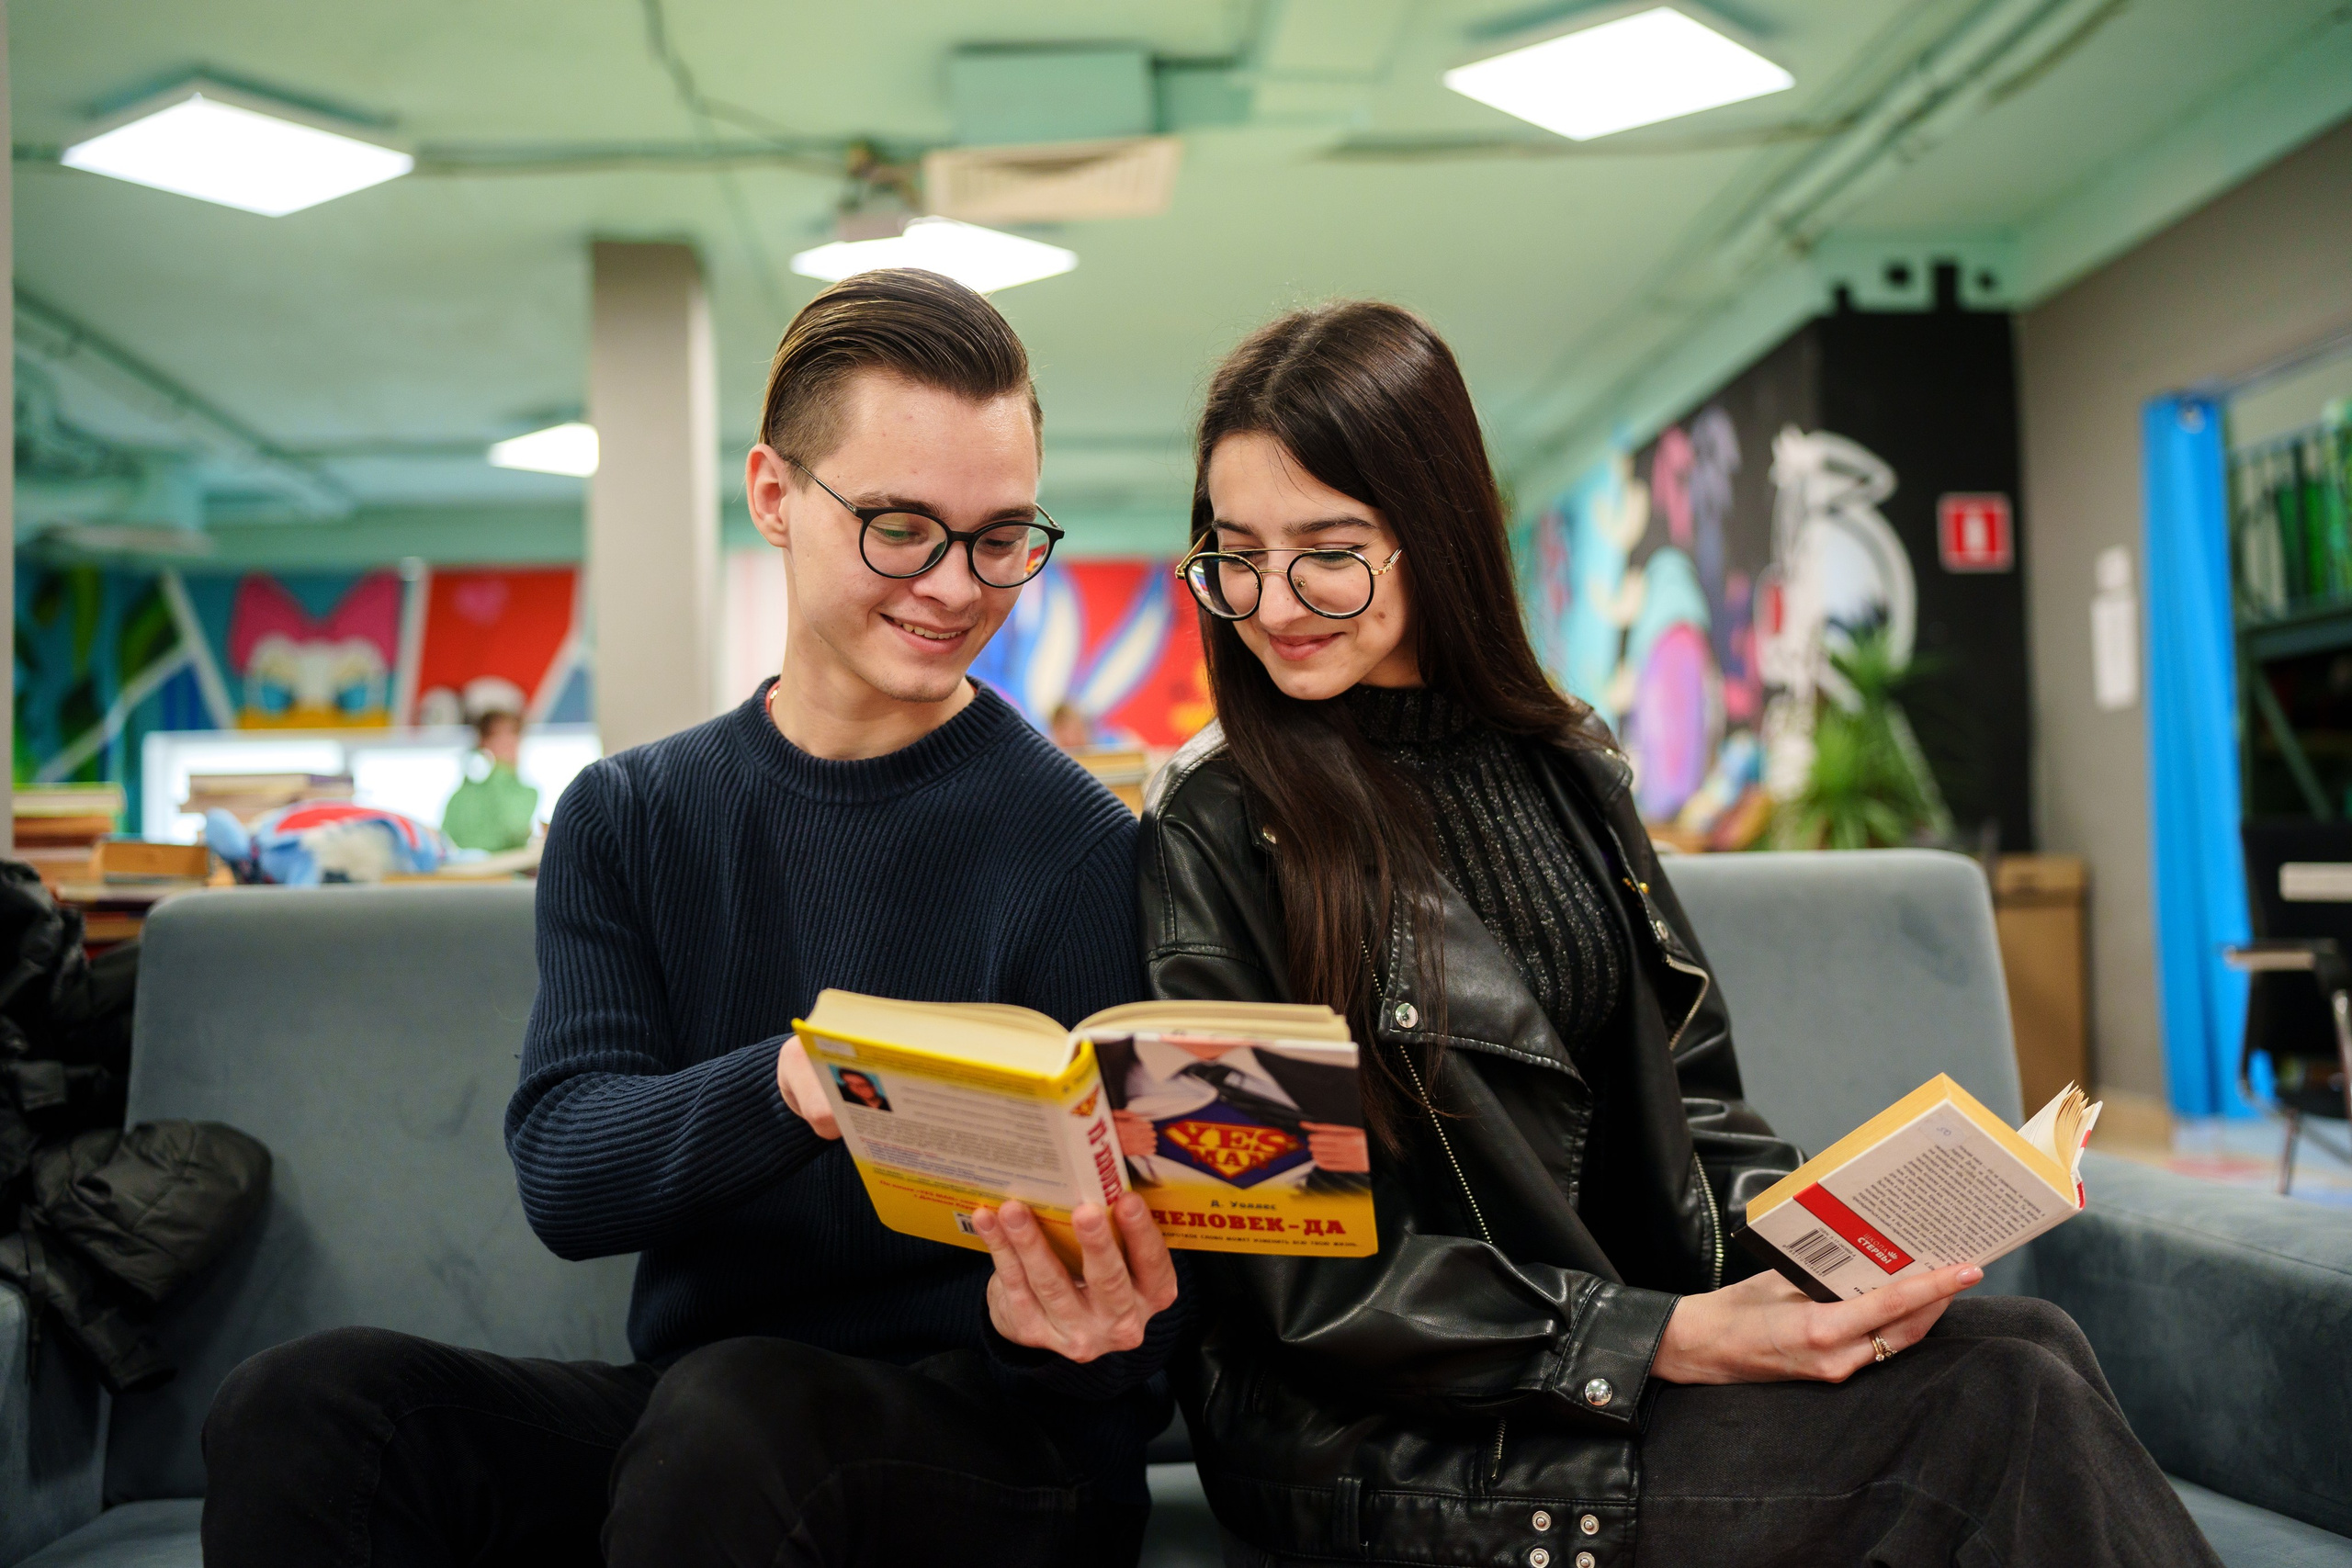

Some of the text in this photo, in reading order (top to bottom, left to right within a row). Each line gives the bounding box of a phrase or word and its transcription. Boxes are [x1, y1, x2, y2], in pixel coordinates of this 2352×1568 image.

[1175, 1123, 1288, 1152] YES
[1193, 1149, 1269, 1168] MAN
[1150, 1209, 1346, 1236] ЧЕЛОВЕК-ДА
[1857, 1236, 1892, 1264] СТЕРВЫ
[1863, 1233, 1887, 1253] ШКОЛА
